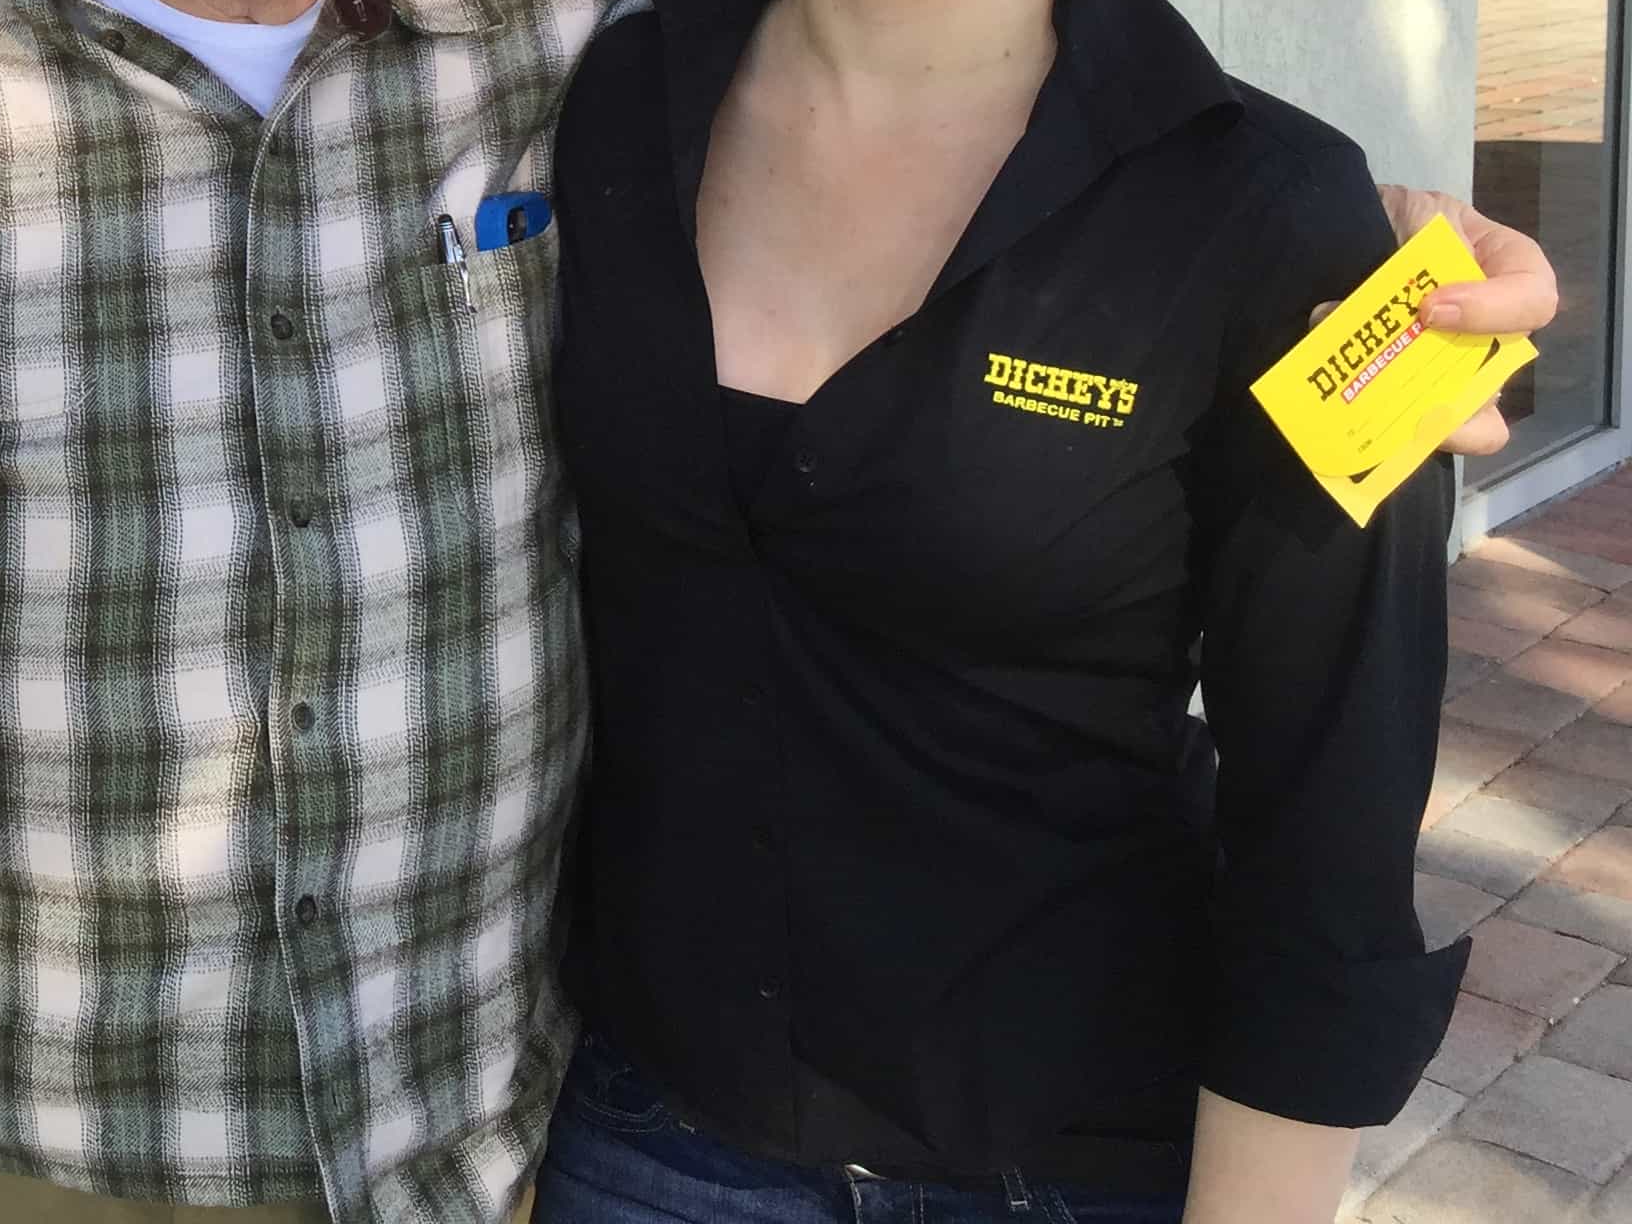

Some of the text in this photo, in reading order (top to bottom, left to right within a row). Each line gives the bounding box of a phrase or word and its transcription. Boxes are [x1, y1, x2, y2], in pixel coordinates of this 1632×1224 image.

[1307, 269, 1439, 402] DICKEY'S
[1342, 332, 1413, 402] BARBECUE
[984, 352, 1138, 414] DICKEY'S
[993, 391, 1111, 428] BARBECUE PIT
